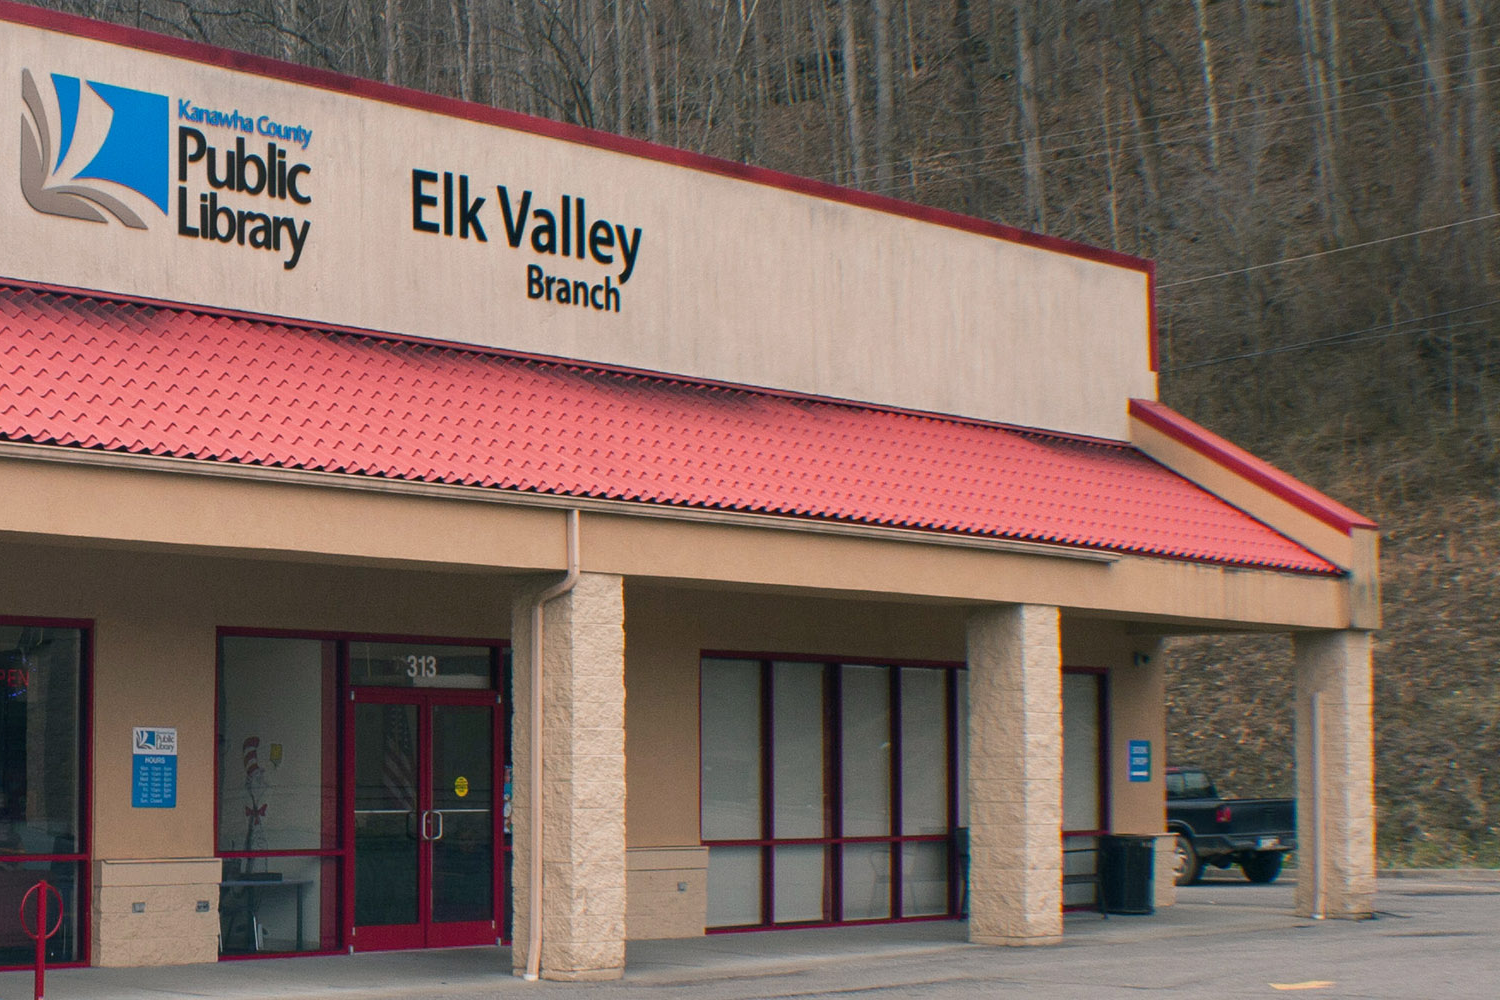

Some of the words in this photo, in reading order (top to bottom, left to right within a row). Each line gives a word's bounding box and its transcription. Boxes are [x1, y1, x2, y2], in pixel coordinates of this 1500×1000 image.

[178, 98, 254, 133] Kanawha
[257, 116, 312, 149] County
[178, 126, 312, 205] Public
[178, 186, 311, 271] Library
[412, 168, 488, 243] Elk
[496, 184, 642, 285] Valley
[527, 264, 621, 313] Branch
[407, 655, 437, 678] 313
[145, 756, 166, 764] HOURS
